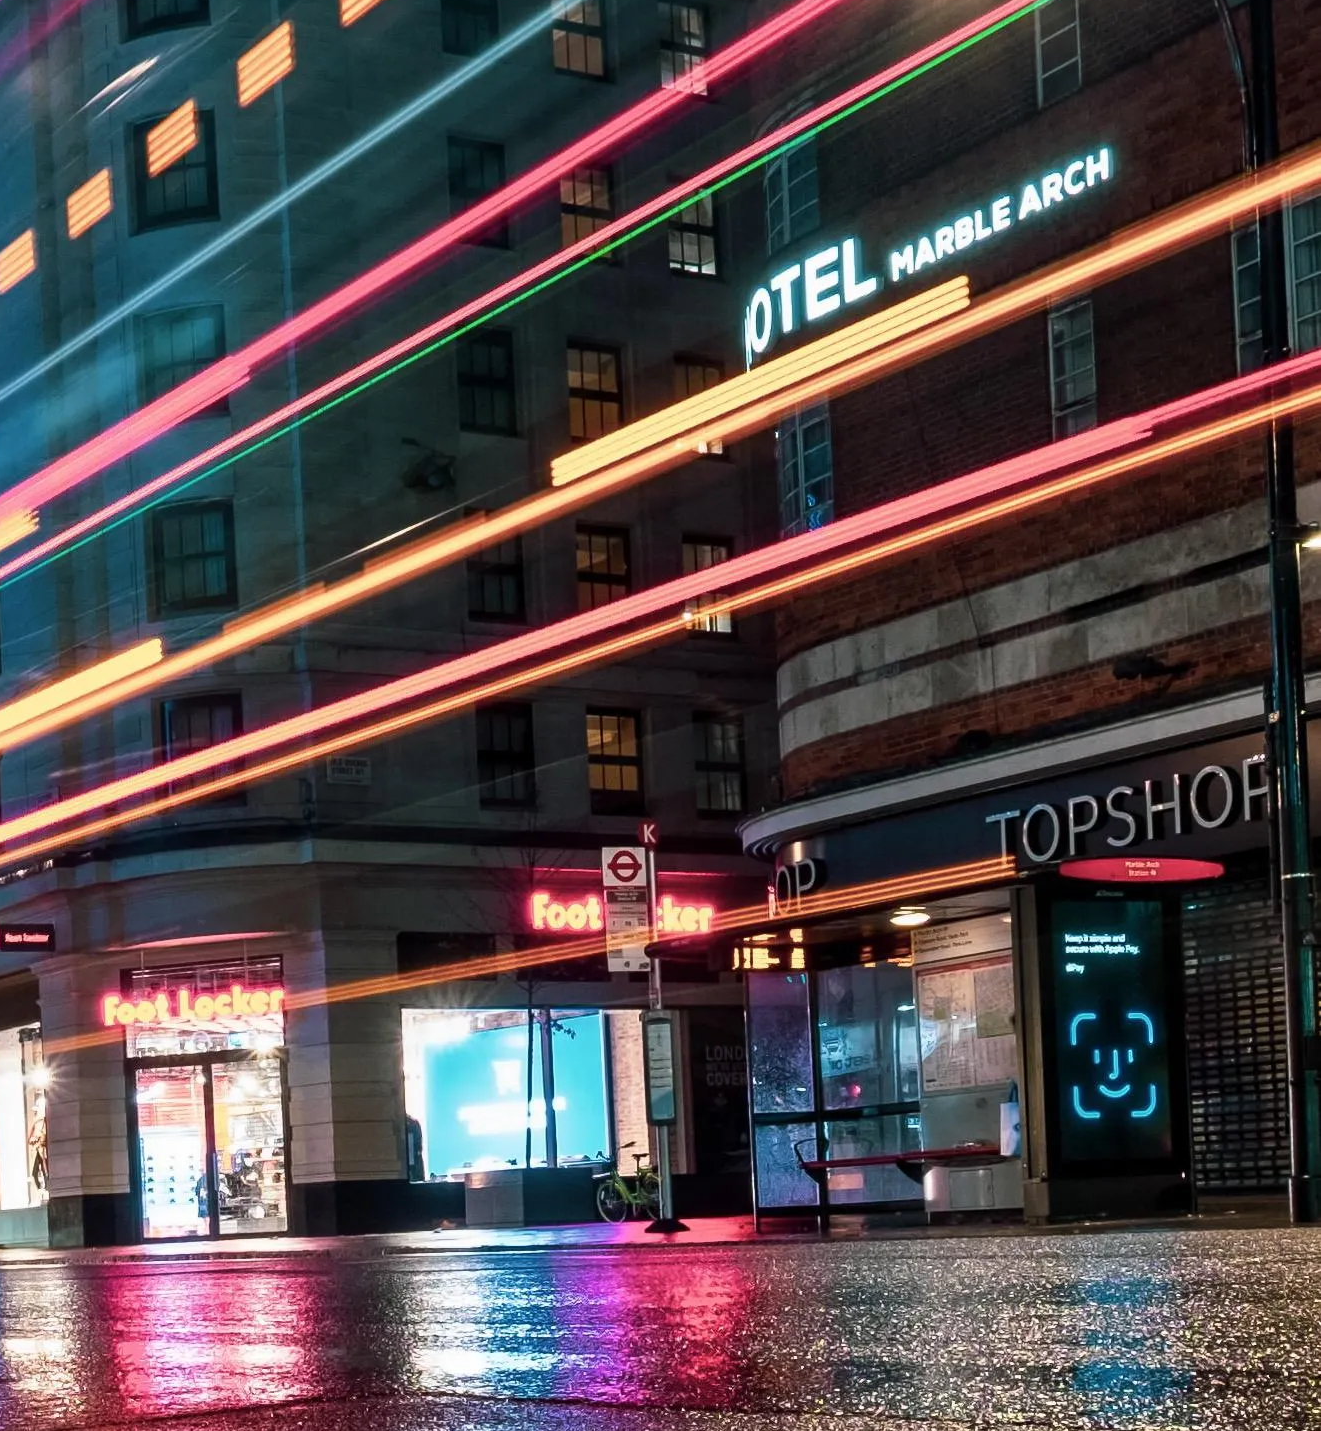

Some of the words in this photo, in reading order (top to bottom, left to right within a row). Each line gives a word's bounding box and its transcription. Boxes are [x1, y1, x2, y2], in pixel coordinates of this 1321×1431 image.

[890, 196, 1011, 282] MARBLE
[1018, 148, 1110, 220] ARCH
[643, 824, 656, 843] K
[532, 894, 604, 930] Foot
[104, 994, 171, 1026] Foot
[180, 984, 285, 1020] Locker
